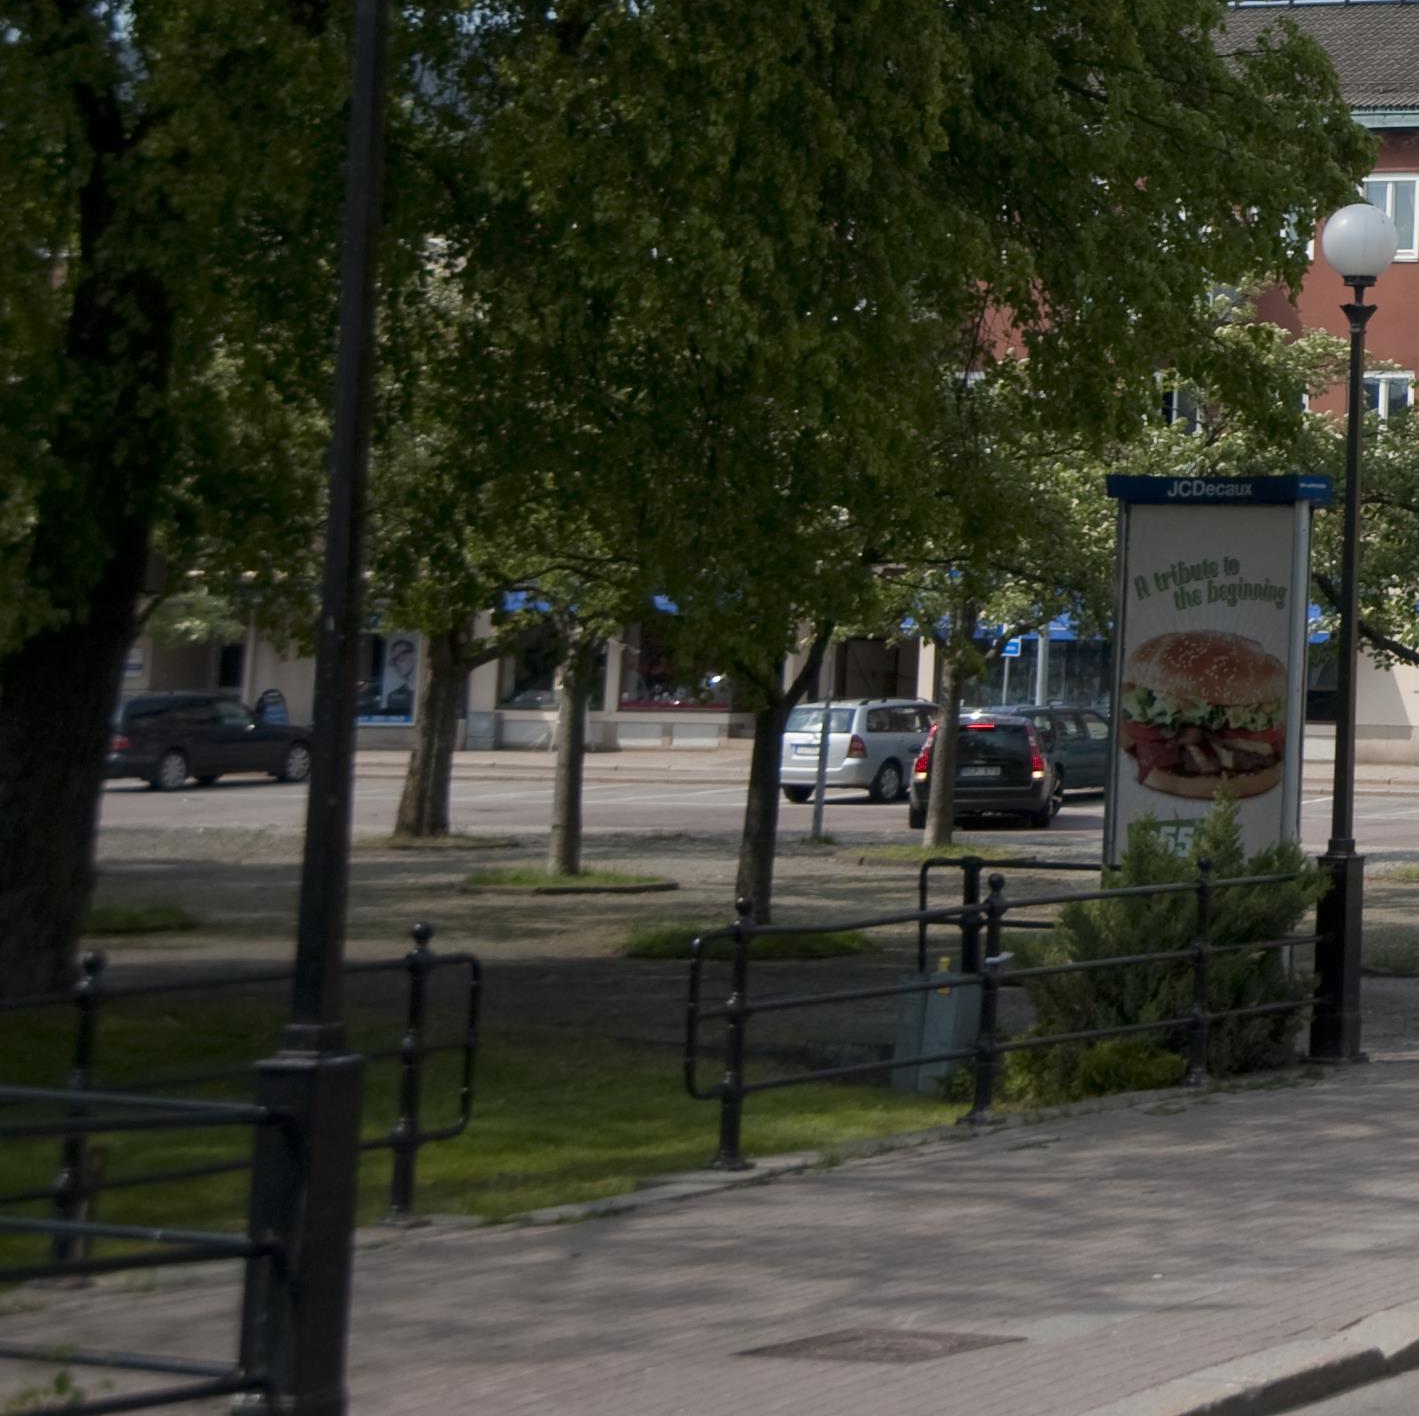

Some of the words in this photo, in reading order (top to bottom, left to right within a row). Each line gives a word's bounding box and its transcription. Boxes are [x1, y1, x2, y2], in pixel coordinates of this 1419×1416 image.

[1166, 479, 1253, 498] JCDecaux
[1134, 575, 1151, 600] A
[1153, 558, 1219, 592] tribute
[1223, 555, 1241, 576] to
[1173, 586, 1202, 610] the
[1207, 576, 1288, 610] beginning
